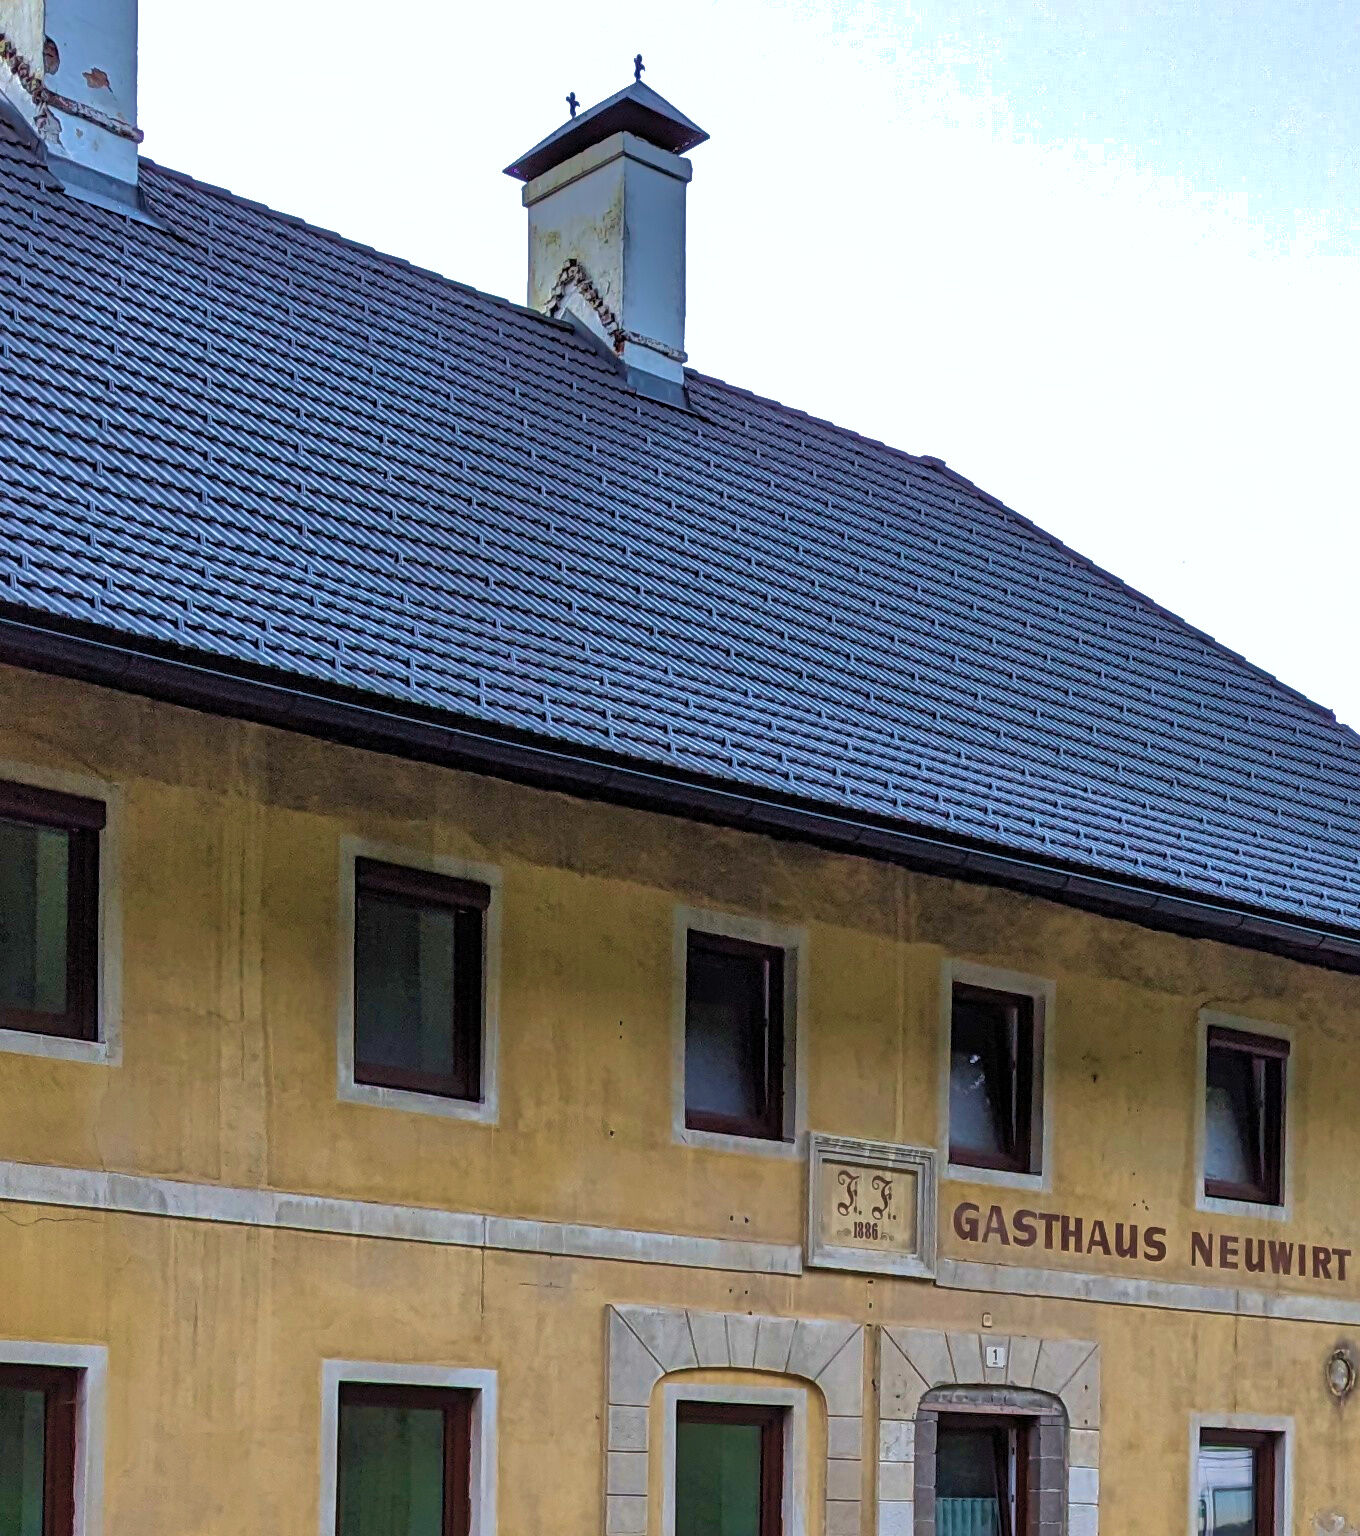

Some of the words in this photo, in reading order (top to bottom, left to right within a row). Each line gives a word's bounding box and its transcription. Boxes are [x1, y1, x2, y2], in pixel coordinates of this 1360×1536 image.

[853, 1221, 878, 1240] 1886
[953, 1202, 1167, 1262] GASTHAUS
[1191, 1231, 1352, 1281] NEUWIRT
[992, 1348, 998, 1361] 1
